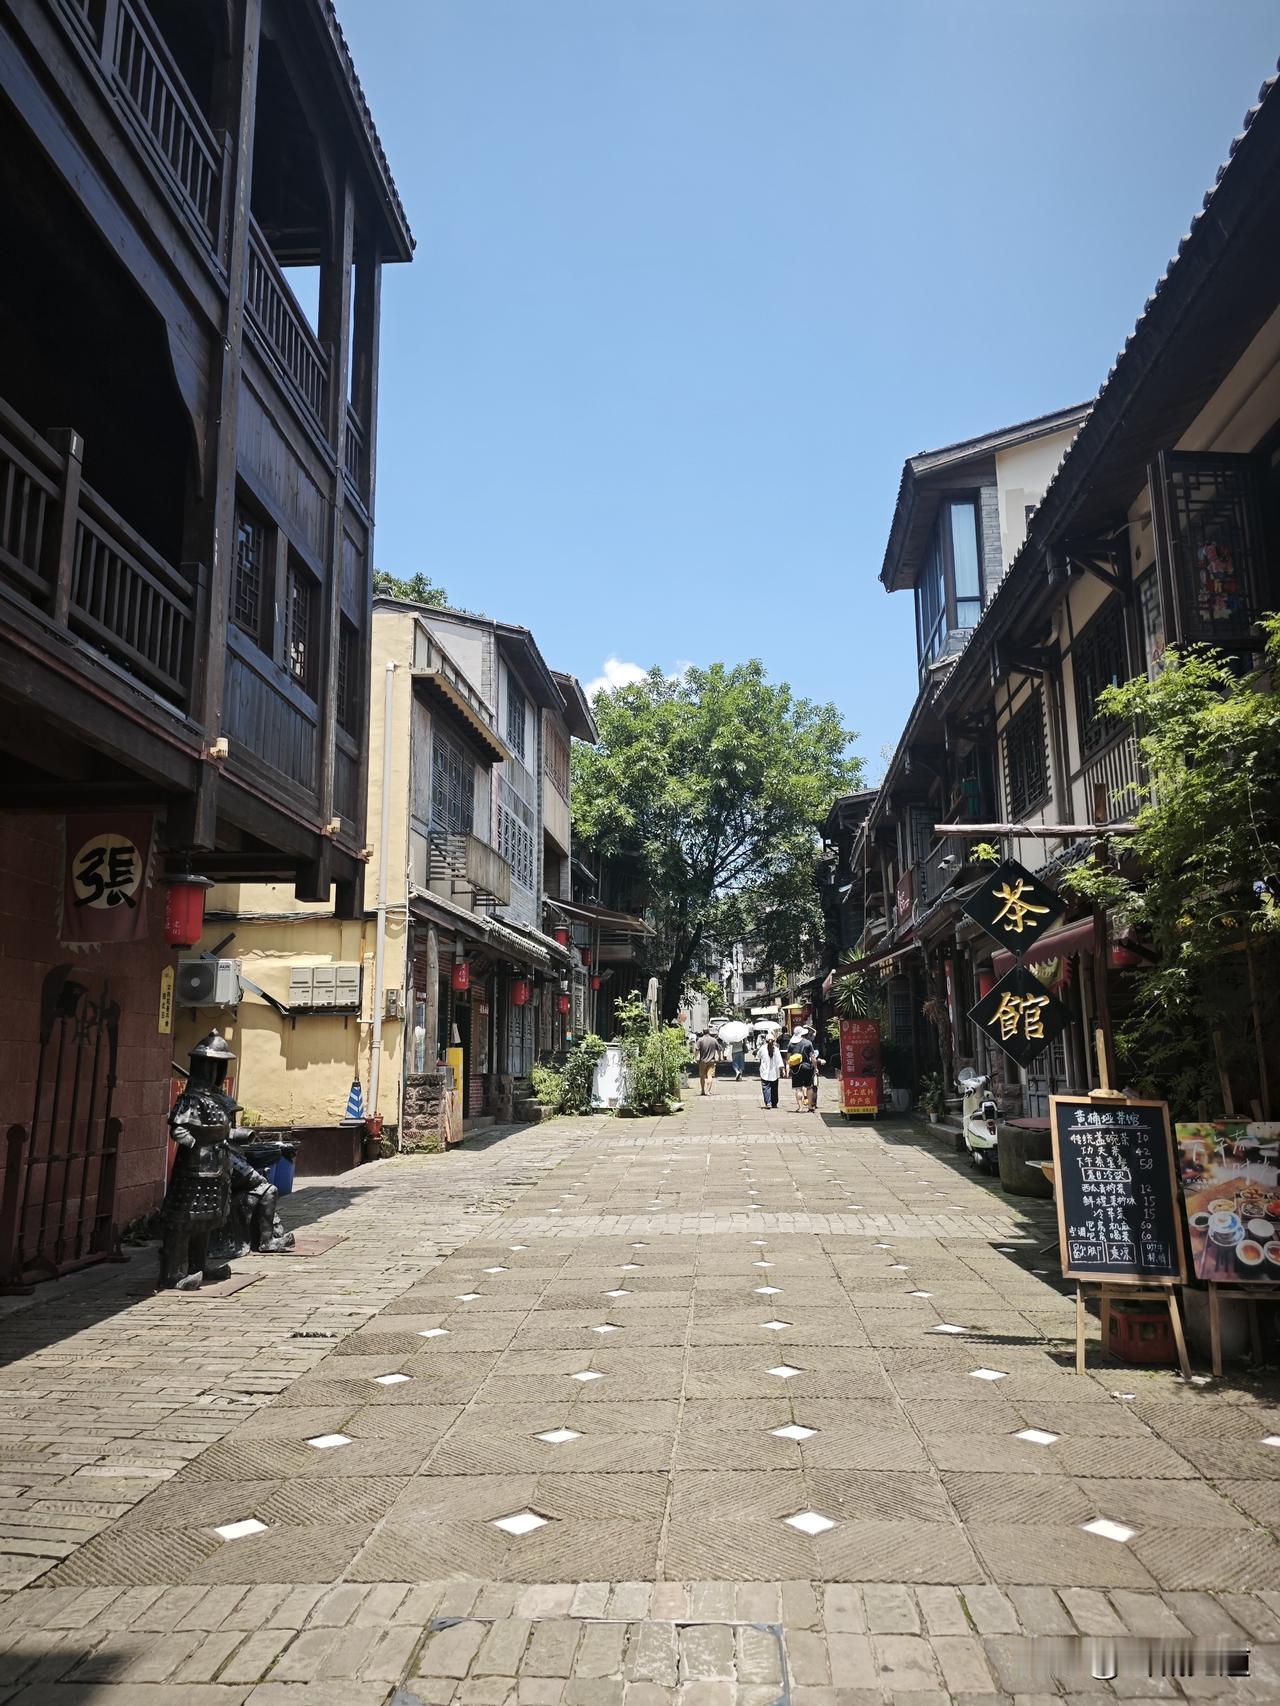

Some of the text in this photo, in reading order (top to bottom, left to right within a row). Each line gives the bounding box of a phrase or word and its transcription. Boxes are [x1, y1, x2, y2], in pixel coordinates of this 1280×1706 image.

[987, 878, 1050, 1041] 茶 館
[1136, 1131, 1149, 1144] 10
[1135, 1148, 1151, 1156] 42
[1139, 1158, 1153, 1170] 58
[1144, 1196, 1156, 1206] 15
[1143, 1208, 1156, 1219] 15
[1141, 1231, 1152, 1240] 60
